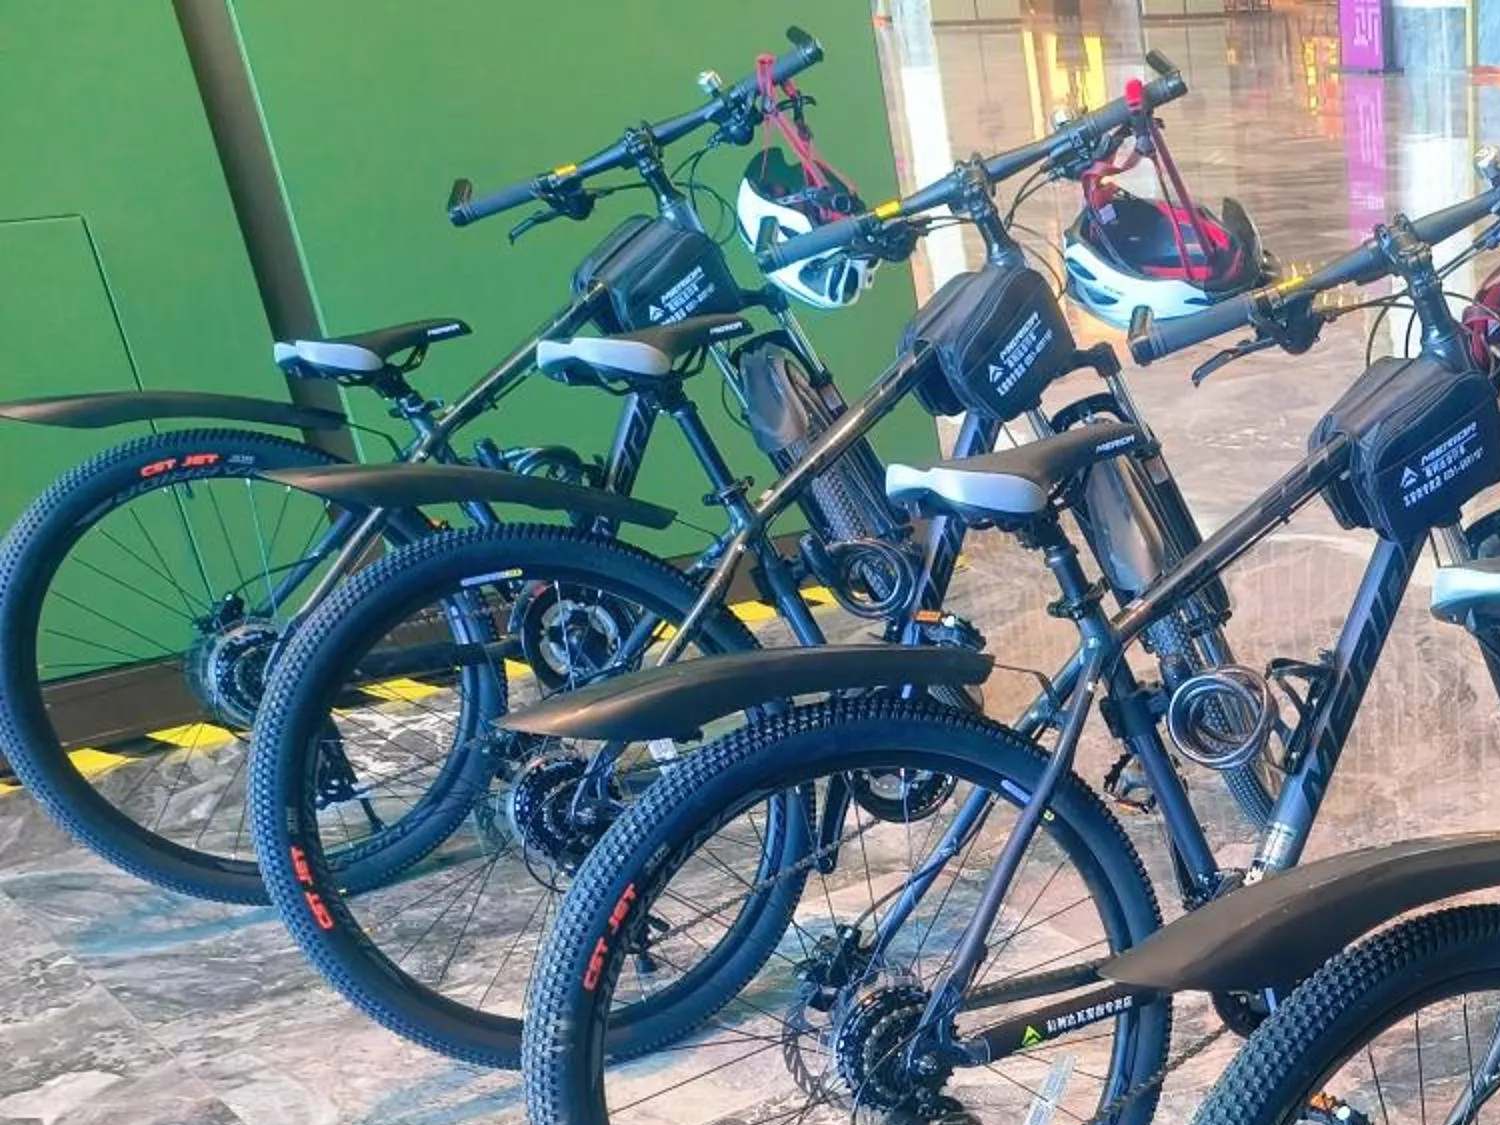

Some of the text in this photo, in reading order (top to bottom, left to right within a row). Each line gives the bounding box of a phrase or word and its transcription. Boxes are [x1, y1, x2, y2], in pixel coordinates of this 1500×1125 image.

[140, 458, 177, 478] CST
[583, 882, 637, 992] CST JET
